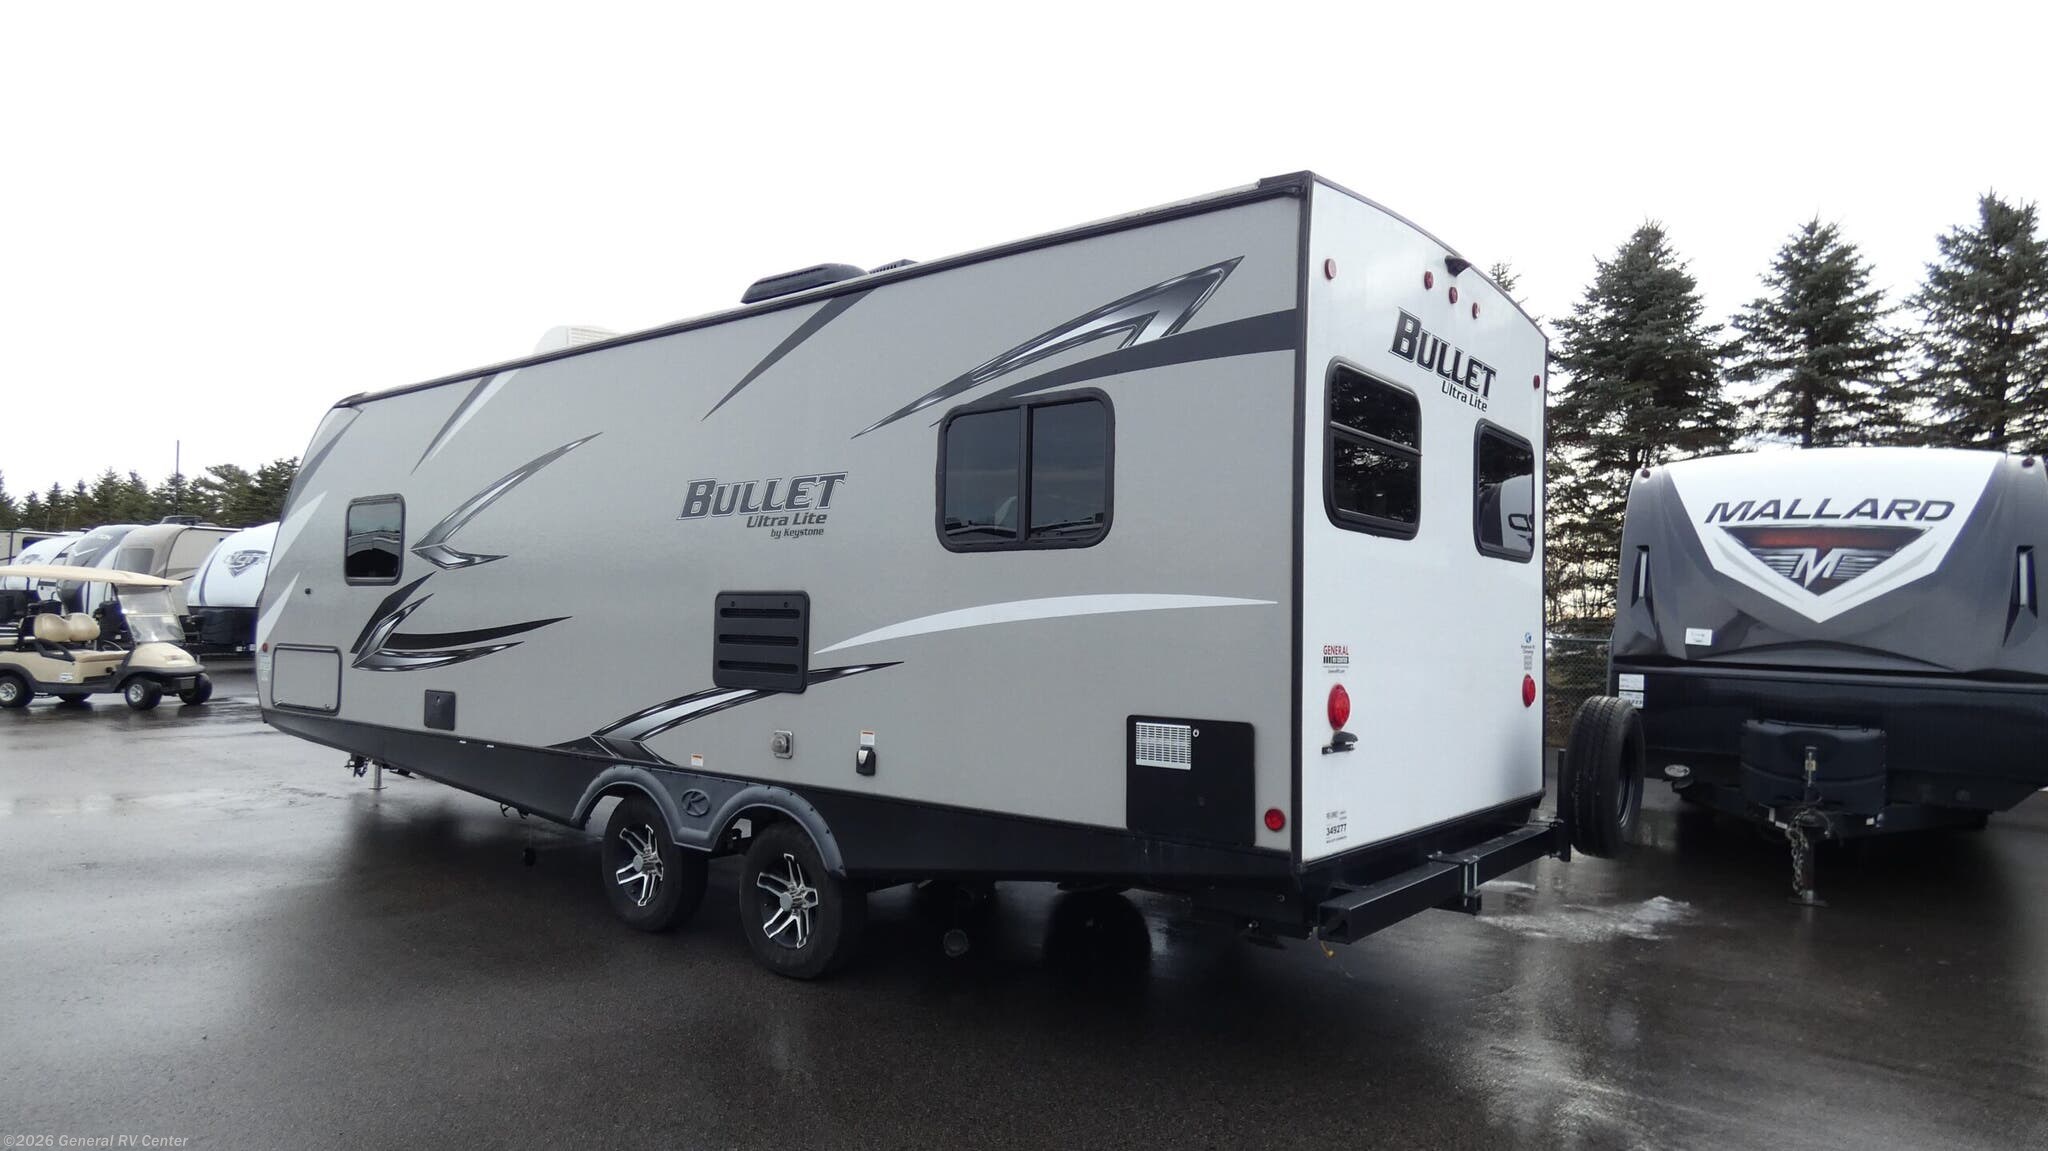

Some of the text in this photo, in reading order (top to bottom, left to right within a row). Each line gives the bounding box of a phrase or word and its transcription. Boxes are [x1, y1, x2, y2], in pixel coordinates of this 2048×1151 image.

[1388, 307, 1497, 400] BULLET
[1441, 380, 1488, 412] Ultra Lite
[676, 471, 848, 520] BULLET
[746, 512, 827, 528] Ultra Lite
[1704, 498, 1955, 524] MALLARD
[770, 528, 824, 539] by Keystone
[1323, 645, 1349, 656] GENERAL
